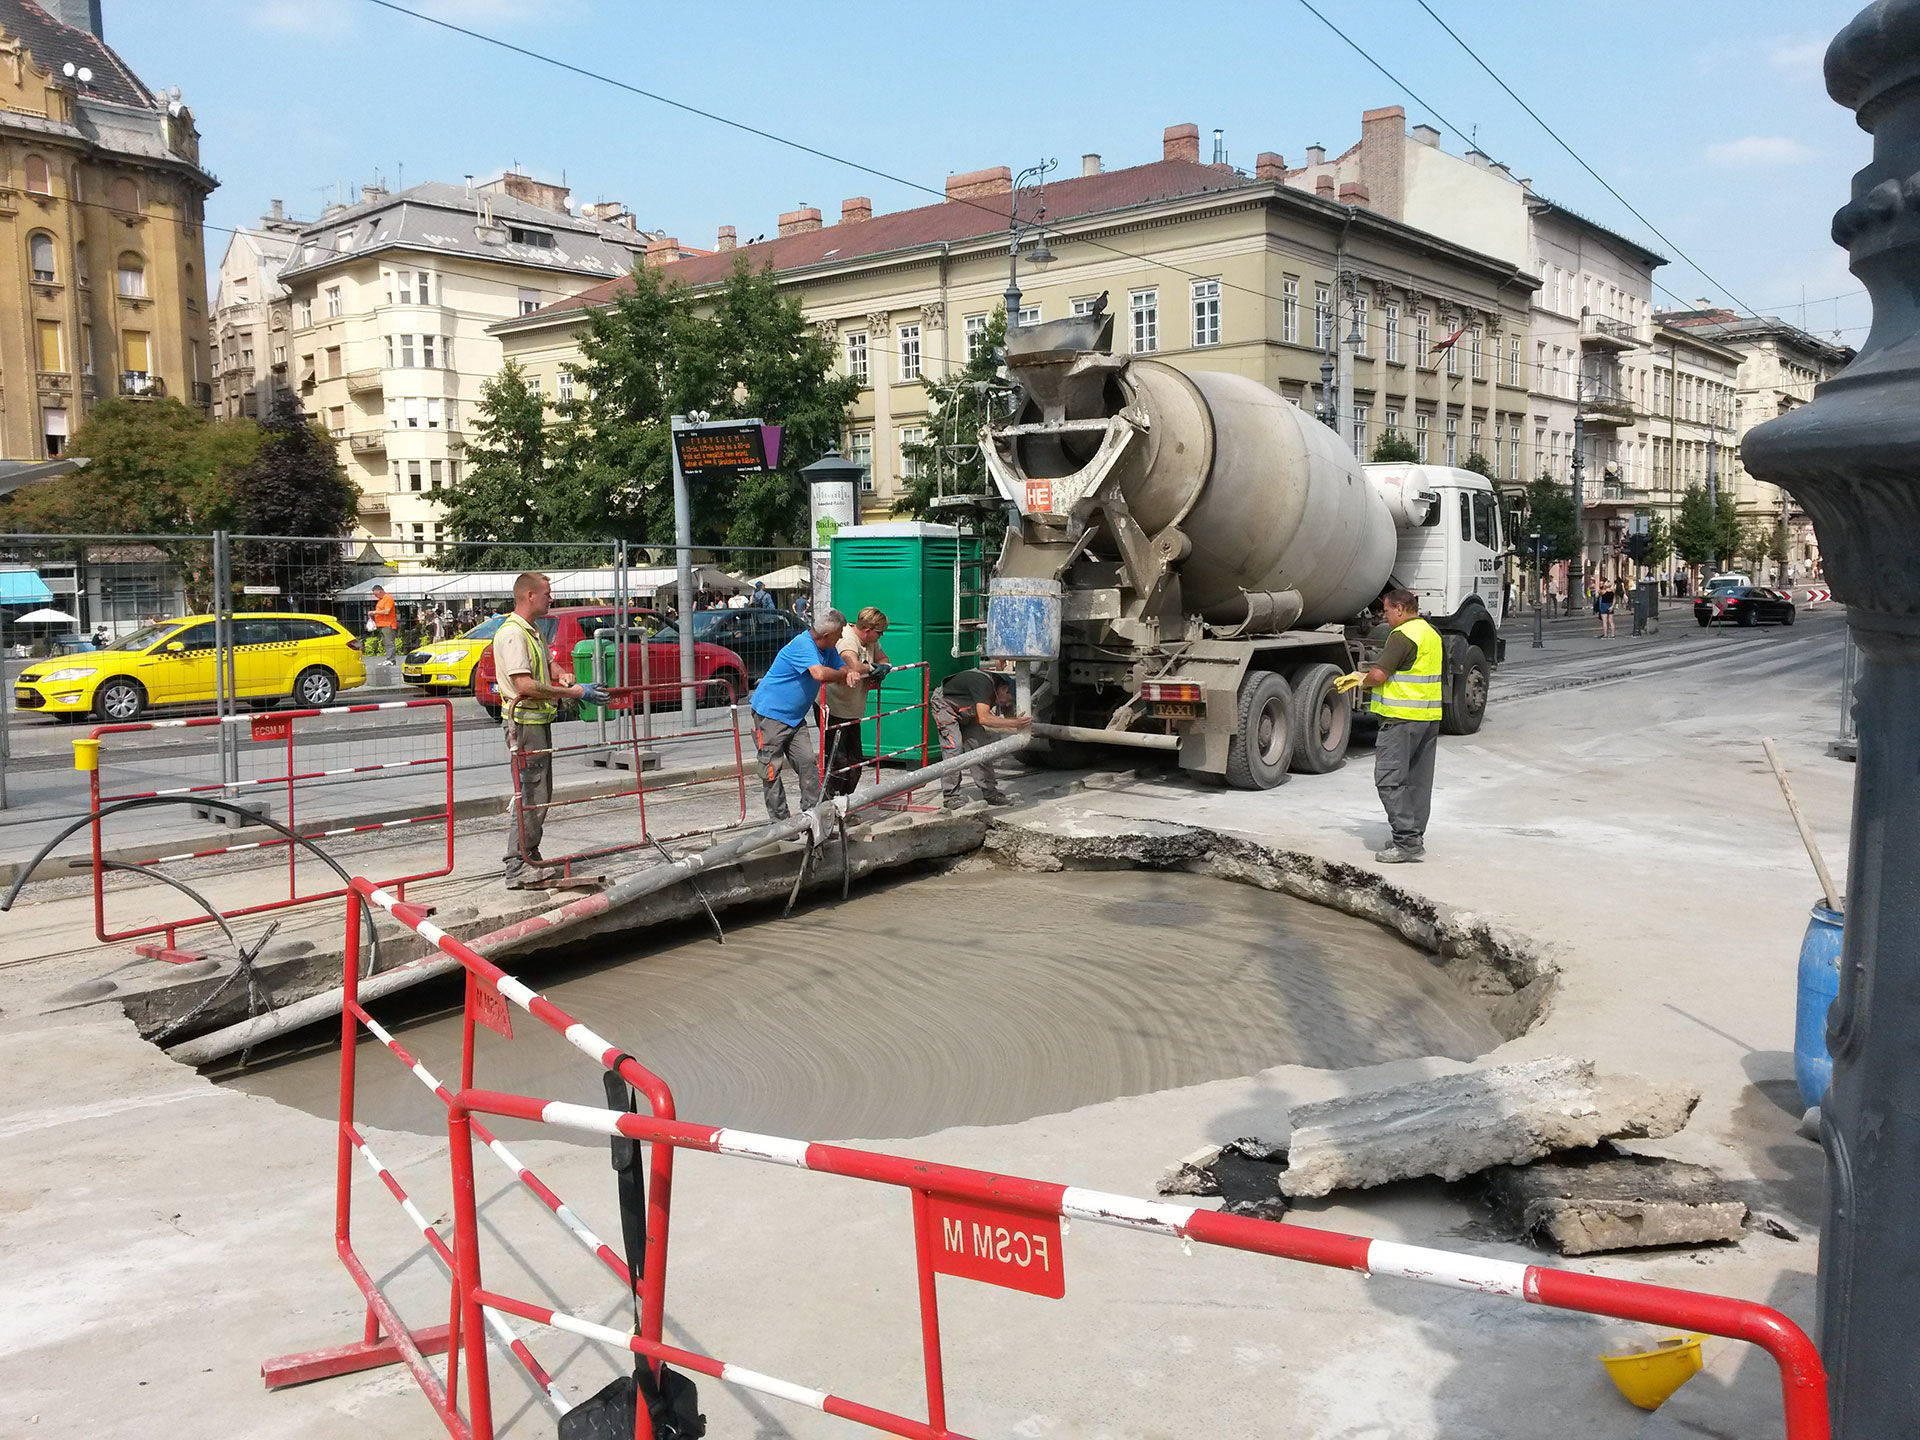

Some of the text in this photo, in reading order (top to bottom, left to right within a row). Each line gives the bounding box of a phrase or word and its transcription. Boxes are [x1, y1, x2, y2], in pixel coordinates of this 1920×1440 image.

[1027, 488, 1050, 505] HE
[815, 520, 850, 531] Budapest
[1479, 559, 1493, 572] TBG
[1155, 704, 1192, 715] TAXI
[254, 725, 285, 737] FCSM M
